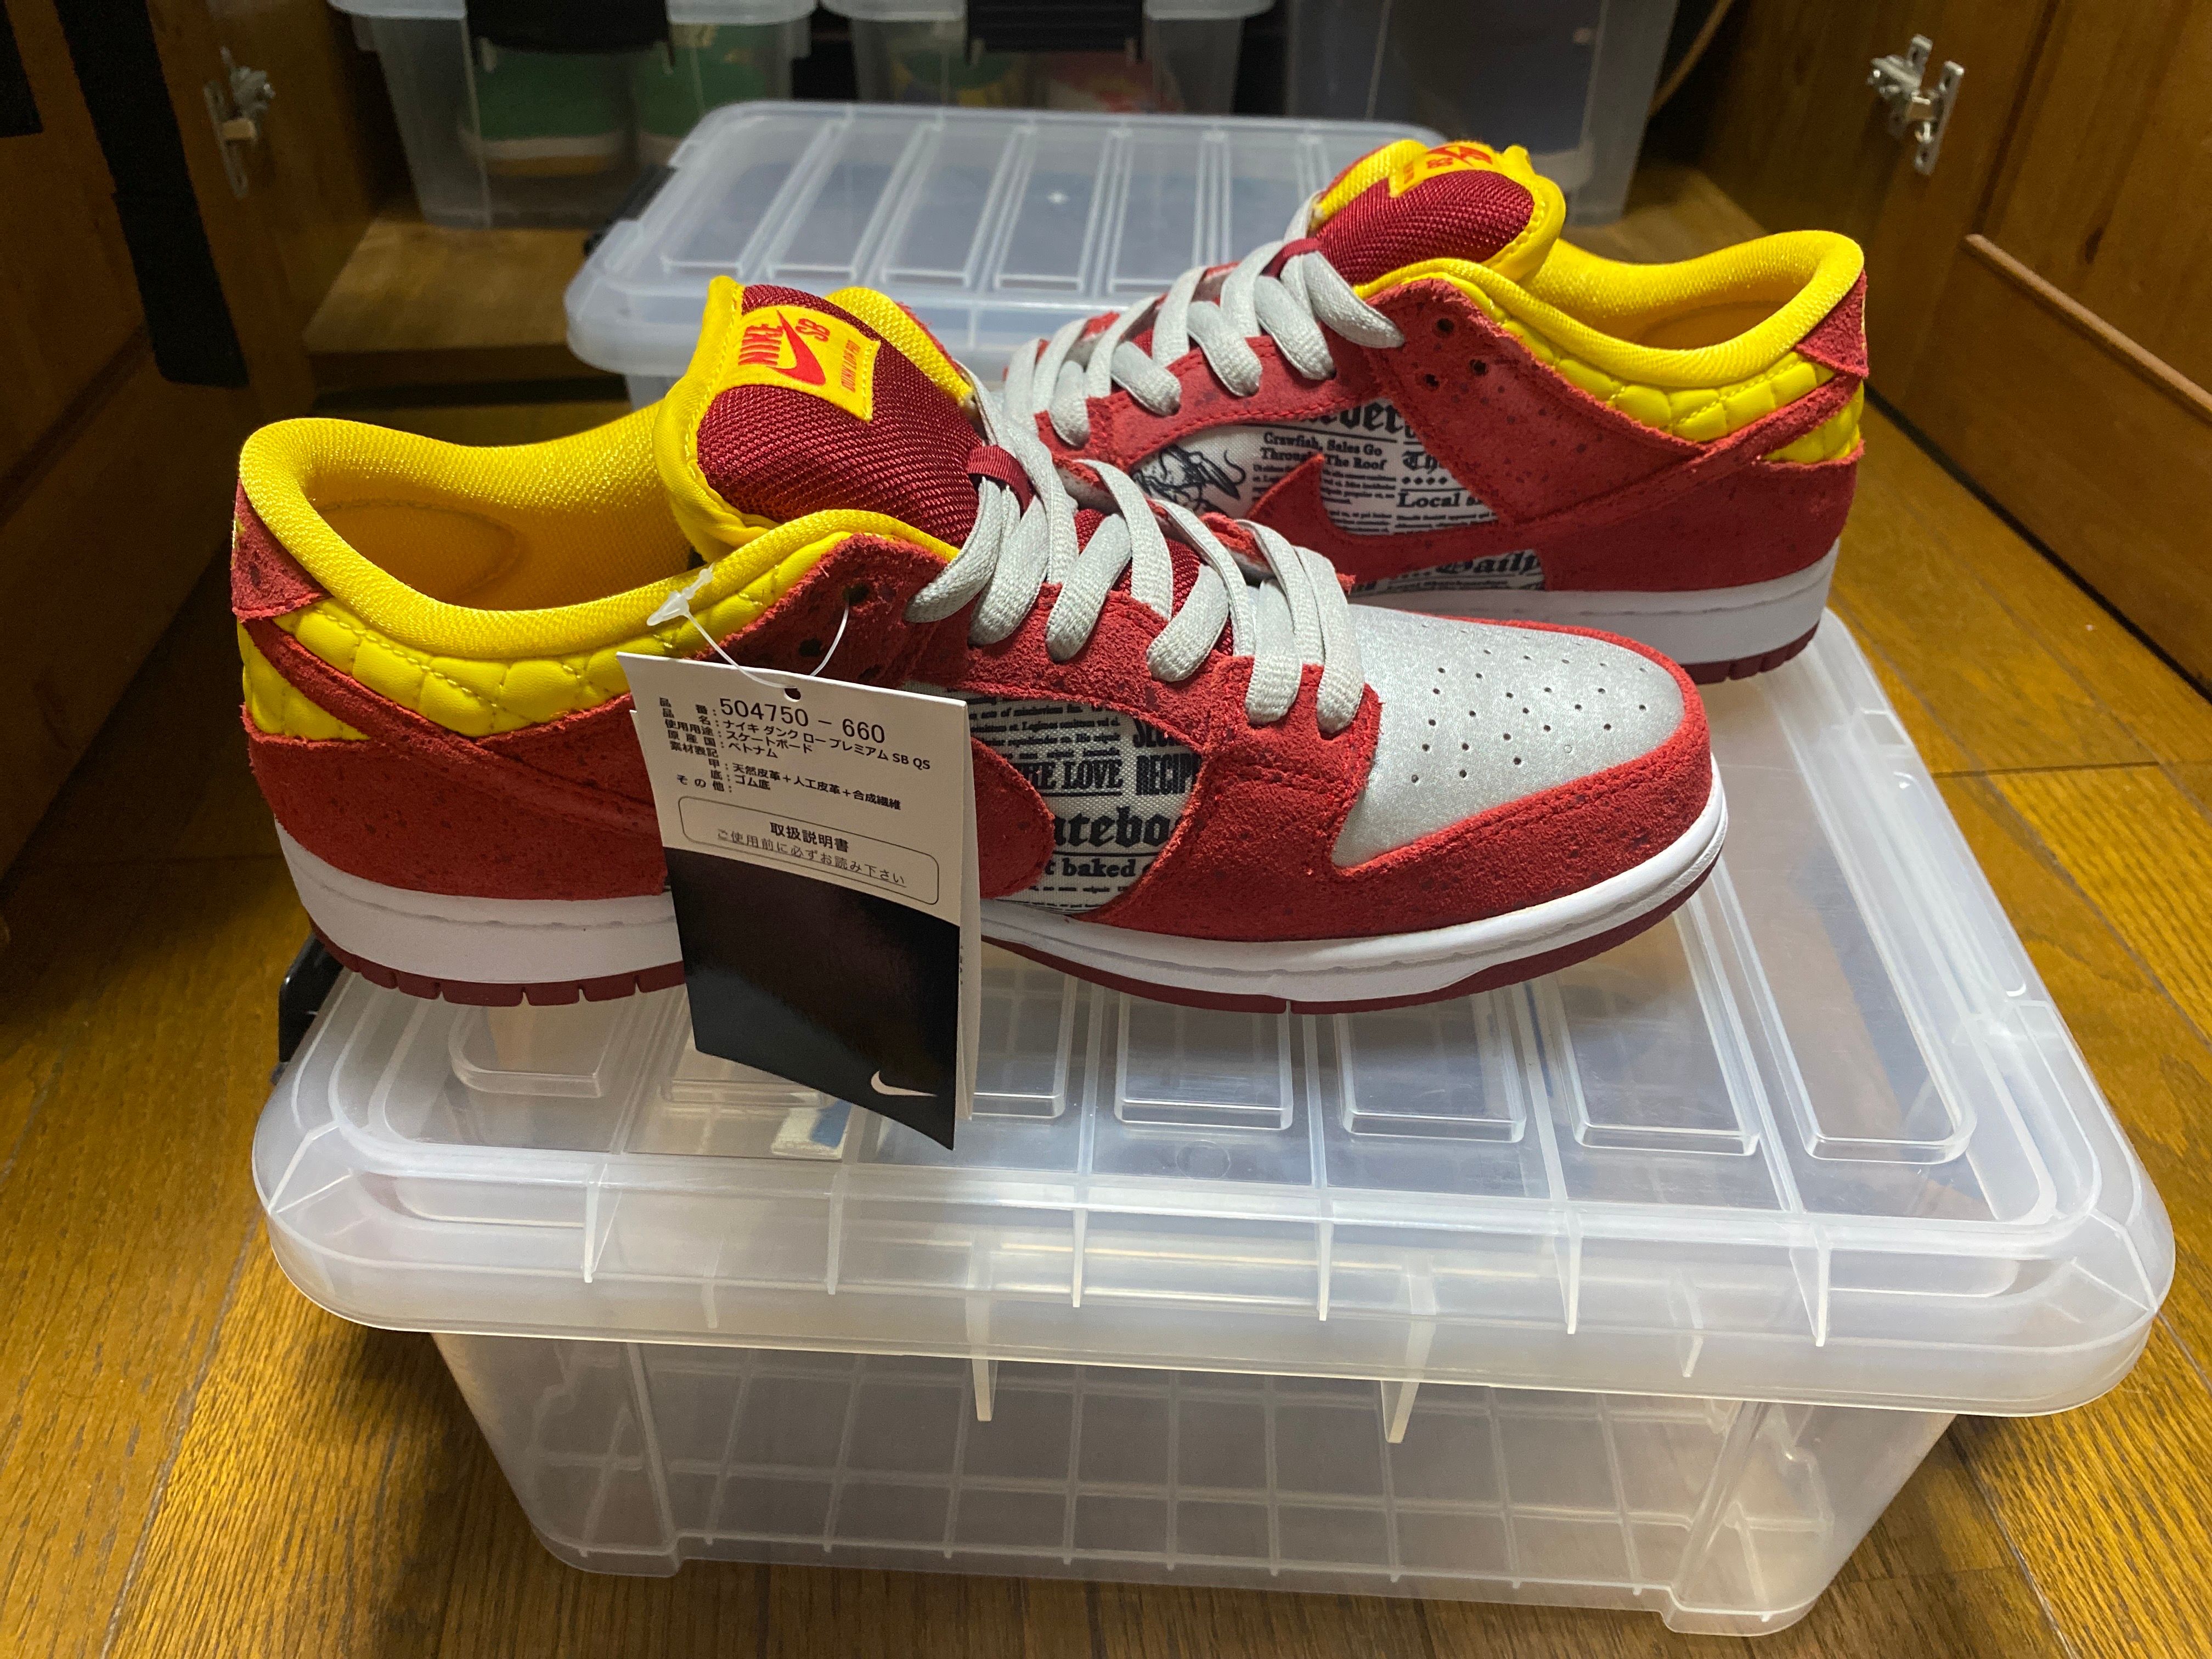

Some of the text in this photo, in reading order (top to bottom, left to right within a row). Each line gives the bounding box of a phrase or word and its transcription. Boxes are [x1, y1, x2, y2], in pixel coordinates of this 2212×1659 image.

[795, 318, 831, 342] SB
[1326, 439, 1361, 454] Sales
[1363, 443, 1383, 456] Go
[1324, 454, 1349, 467] The
[1353, 457, 1387, 471] Roof
[1396, 492, 1460, 507] Local
[719, 698, 809, 726] 504750
[842, 719, 885, 743] 660
[723, 720, 759, 733] ナイキ
[764, 725, 798, 739] ダンク
[893, 753, 909, 764] SB
[913, 758, 931, 770] QS
[726, 730, 813, 754] スケートボード
[728, 742, 778, 758] ベトナム
[734, 774, 771, 791] ゴム底
[1062, 760, 1124, 789] LOVE
[769, 821, 849, 853] 取扱説明書
[717, 828, 906, 884] ご使用前に必ずお読み下さい
[1062, 857, 1136, 877] baked
